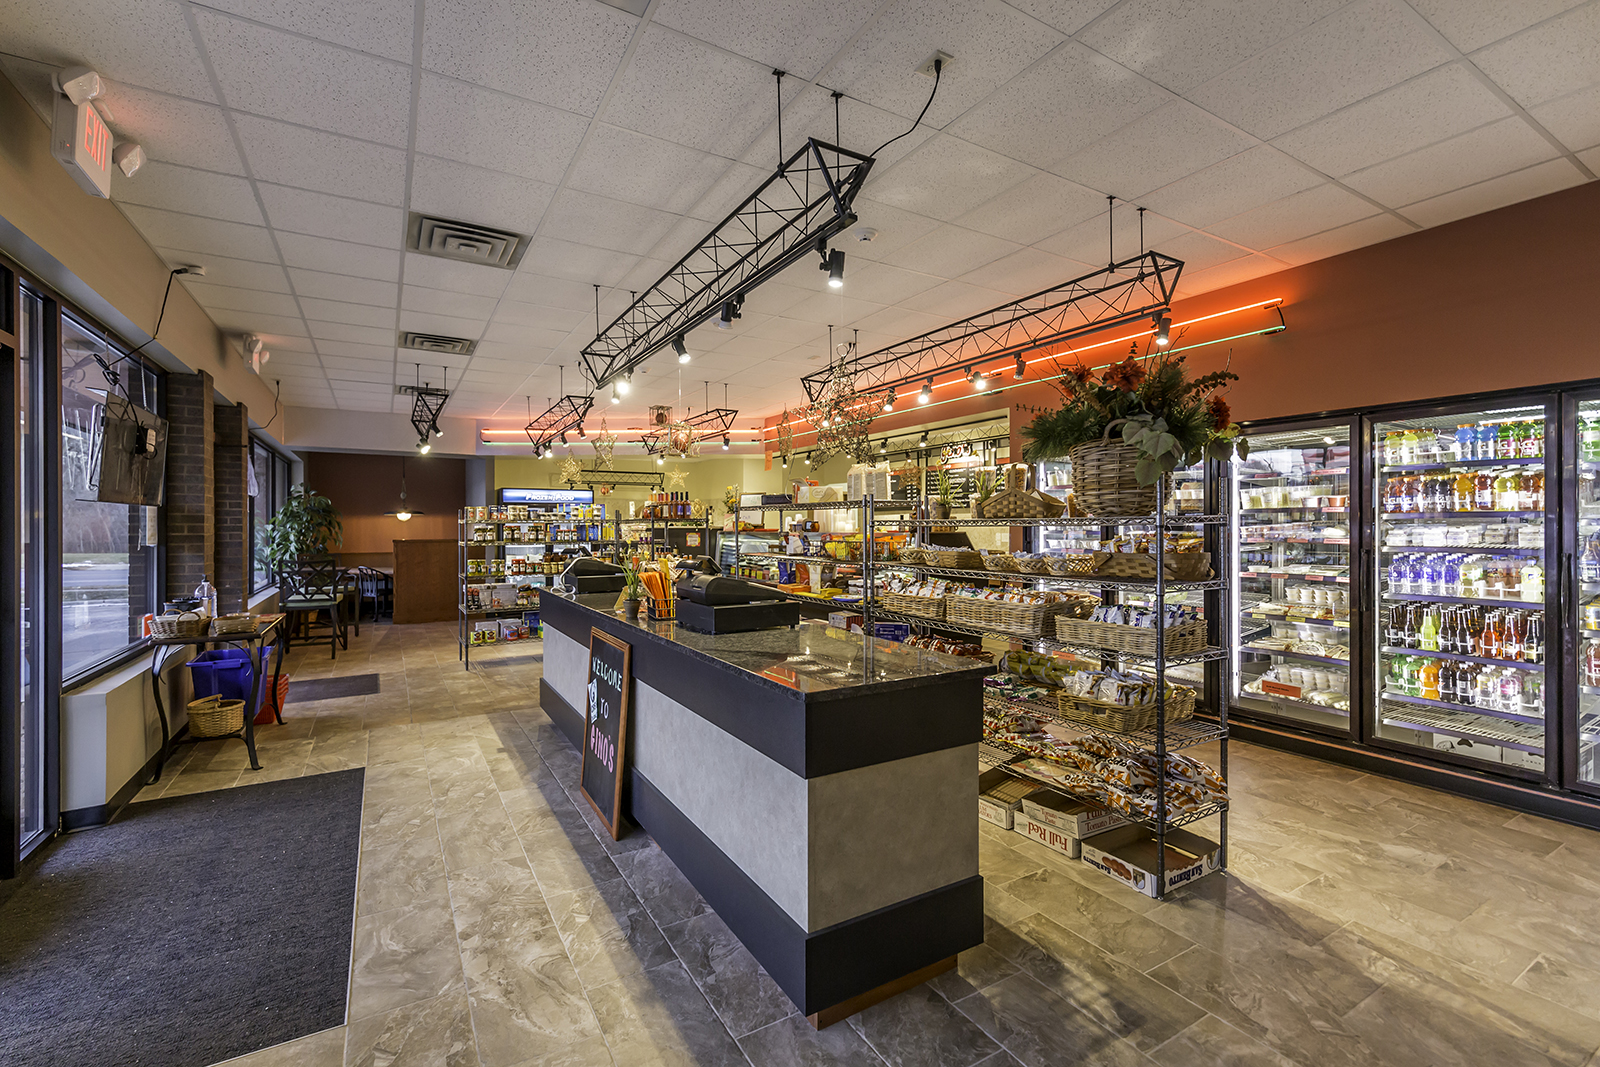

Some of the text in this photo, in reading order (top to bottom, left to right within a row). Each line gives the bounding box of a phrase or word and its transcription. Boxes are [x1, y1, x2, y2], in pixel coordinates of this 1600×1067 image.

[85, 105, 109, 172] EXIT
[592, 657, 623, 692] WELCOME
[601, 697, 609, 719] TO
[590, 724, 614, 773] GINO'S
[1040, 807, 1057, 819] Tomato
[1085, 821, 1107, 831] Tomato
[1028, 821, 1068, 851] Full Red
[1169, 864, 1203, 887] SAN BENITO
